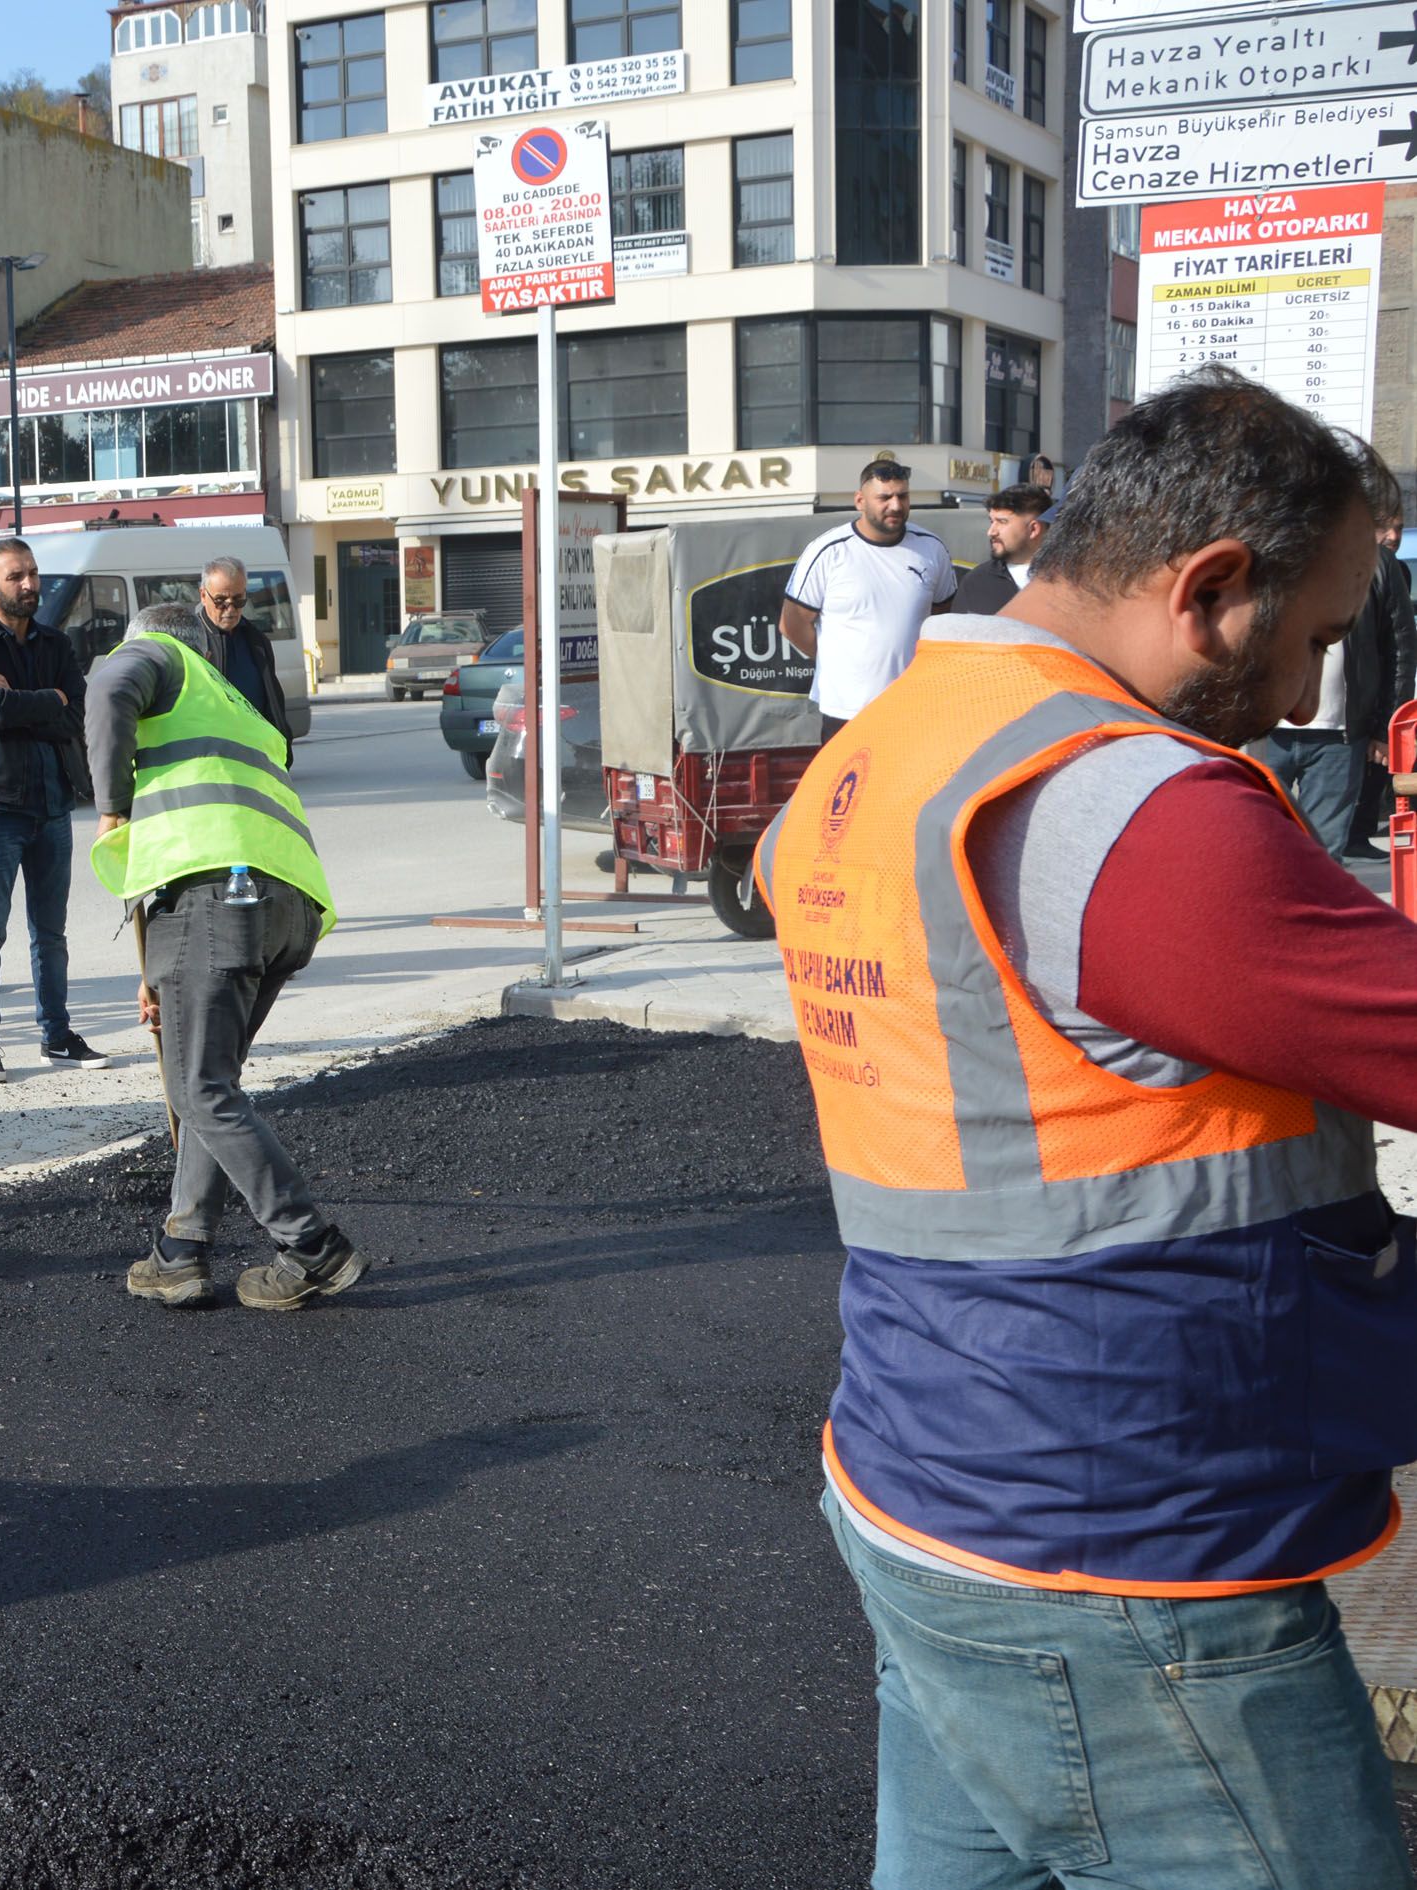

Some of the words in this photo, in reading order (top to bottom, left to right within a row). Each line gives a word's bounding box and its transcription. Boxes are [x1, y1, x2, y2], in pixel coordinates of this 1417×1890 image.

[1108, 43, 1201, 68] Havza
[1214, 28, 1325, 57] Yeraltı
[586, 67, 593, 76] 0
[597, 64, 617, 76] 545
[620, 60, 641, 72] 320
[645, 58, 659, 69] 35
[663, 56, 677, 66] 55
[1106, 70, 1228, 99] Mekanik
[1239, 57, 1371, 87] Otoparkı
[439, 71, 554, 101] AVUKAT
[587, 80, 594, 90] 0
[598, 77, 618, 90] 542
[622, 74, 642, 86] 792
[646, 72, 660, 82] 90
[663, 69, 677, 80] 29
[433, 97, 495, 122] FATİH
[503, 90, 562, 114] YİĞİT
[1094, 123, 1168, 140] Samsun
[1178, 112, 1286, 136] Büyükşehir
[1295, 102, 1395, 126] Belediyesi
[1093, 142, 1180, 166] Havza
[1091, 168, 1199, 192] Cenaze
[1209, 152, 1374, 186] Hizmetleri
[502, 192, 520, 204] BU
[523, 183, 580, 201] CADDEDE
[1224, 195, 1297, 217] HAVZA
[483, 204, 533, 221] 08.00
[551, 192, 602, 210] 20.00
[495, 233, 521, 246] TEK
[533, 222, 594, 242] SEFERDE
[1154, 220, 1252, 248] MEKANİK
[1259, 212, 1368, 238] OTOPARKI
[495, 246, 510, 258] 40
[496, 260, 534, 274] FAZLA
[538, 250, 595, 270] SÜREYLE
[1174, 255, 1228, 278] FİYAT
[1234, 243, 1352, 272] TARİFELERİ
[489, 276, 522, 292] ARAÇ
[525, 271, 558, 286] PARK
[560, 266, 604, 282] ETMEK
[1166, 286, 1212, 299] ZAMAN
[1216, 281, 1256, 296] DİLİMİ
[1296, 275, 1341, 288] ÜCRET
[490, 280, 605, 310] YASAKTIR
[1170, 304, 1178, 314] 0
[1190, 302, 1204, 312] 15
[1208, 298, 1250, 312] Dakika
[1285, 290, 1350, 305] ÜCRETSİZ
[1166, 320, 1182, 330] 16
[1192, 318, 1207, 329] 60
[1210, 315, 1254, 327] Dakika
[1180, 336, 1186, 346] 1
[1198, 334, 1206, 344] 2
[1209, 333, 1238, 344] Saat
[1179, 352, 1186, 362] 2
[1198, 351, 1206, 361] 3
[1209, 350, 1238, 361] Saat
[66, 374, 170, 406] LAHMACUN
[188, 362, 255, 396] DÖNER
[740, 667, 776, 681] Düğün
[825, 955, 886, 998] BAKIM
[812, 1005, 858, 1048] ONARIM
